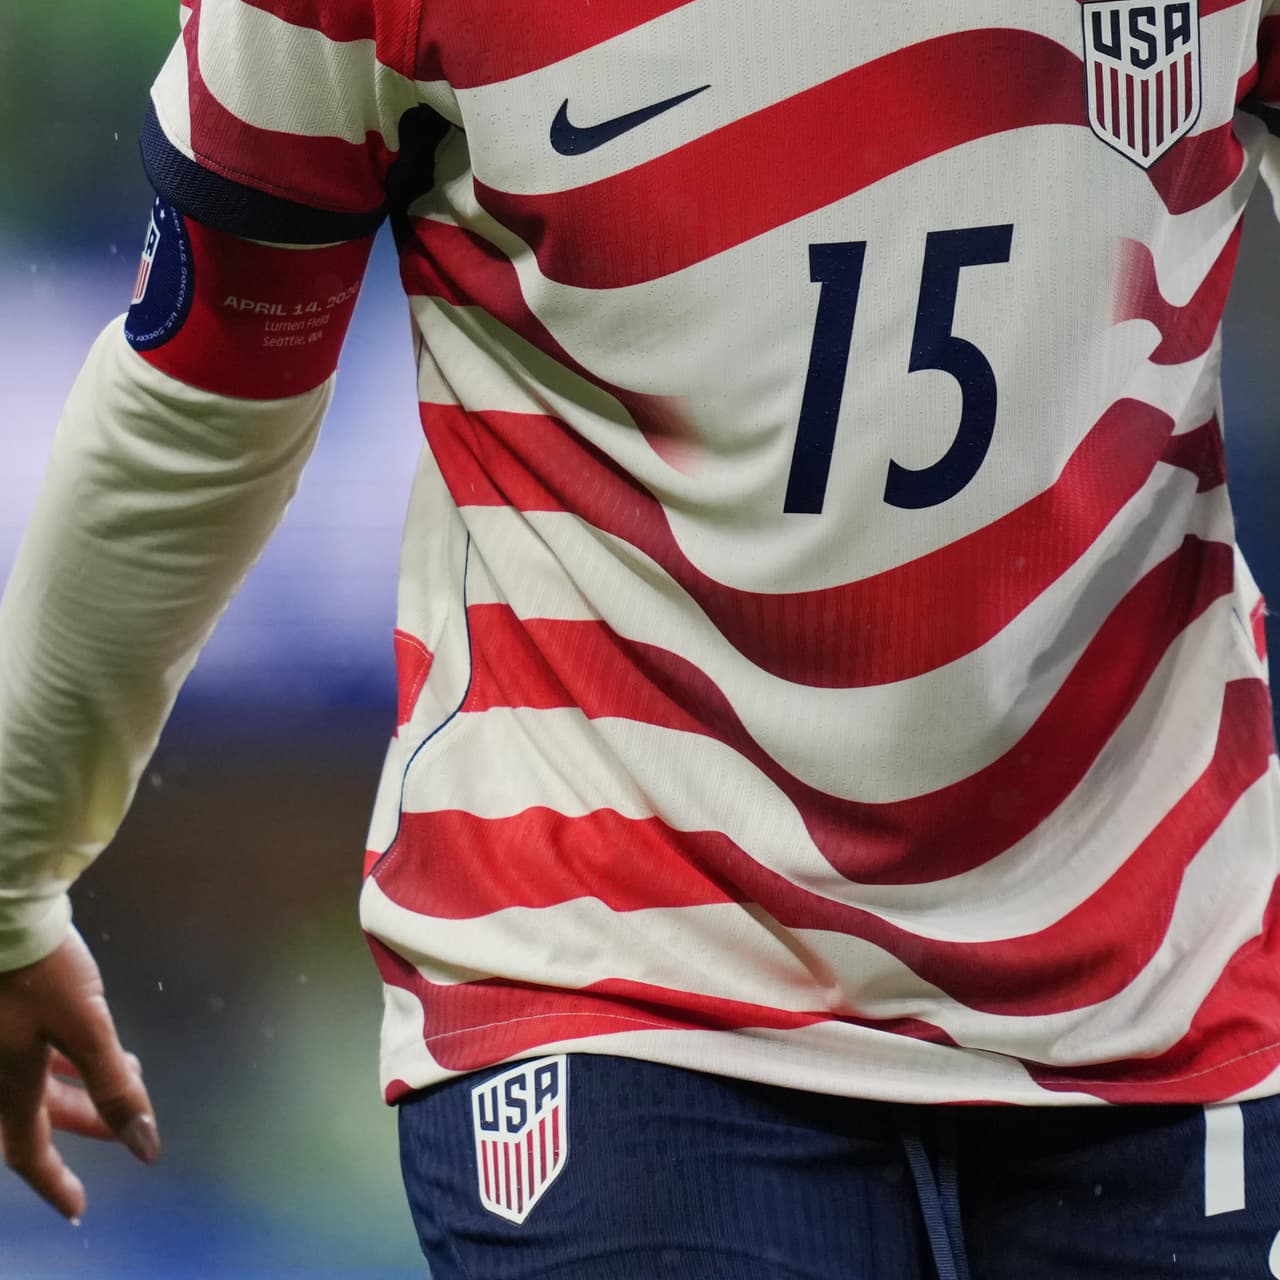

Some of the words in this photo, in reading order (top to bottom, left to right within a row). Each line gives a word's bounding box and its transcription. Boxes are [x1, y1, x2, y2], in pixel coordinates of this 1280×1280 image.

[1091, 1, 1191, 70] USA
[175, 266, 188, 310] Soccer
[223, 295, 287, 316] APRIL
[264, 319, 305, 332] Lumen
[306, 313, 331, 329] Field
[782, 223, 1014, 515] 15
[478, 1061, 559, 1133] USA
